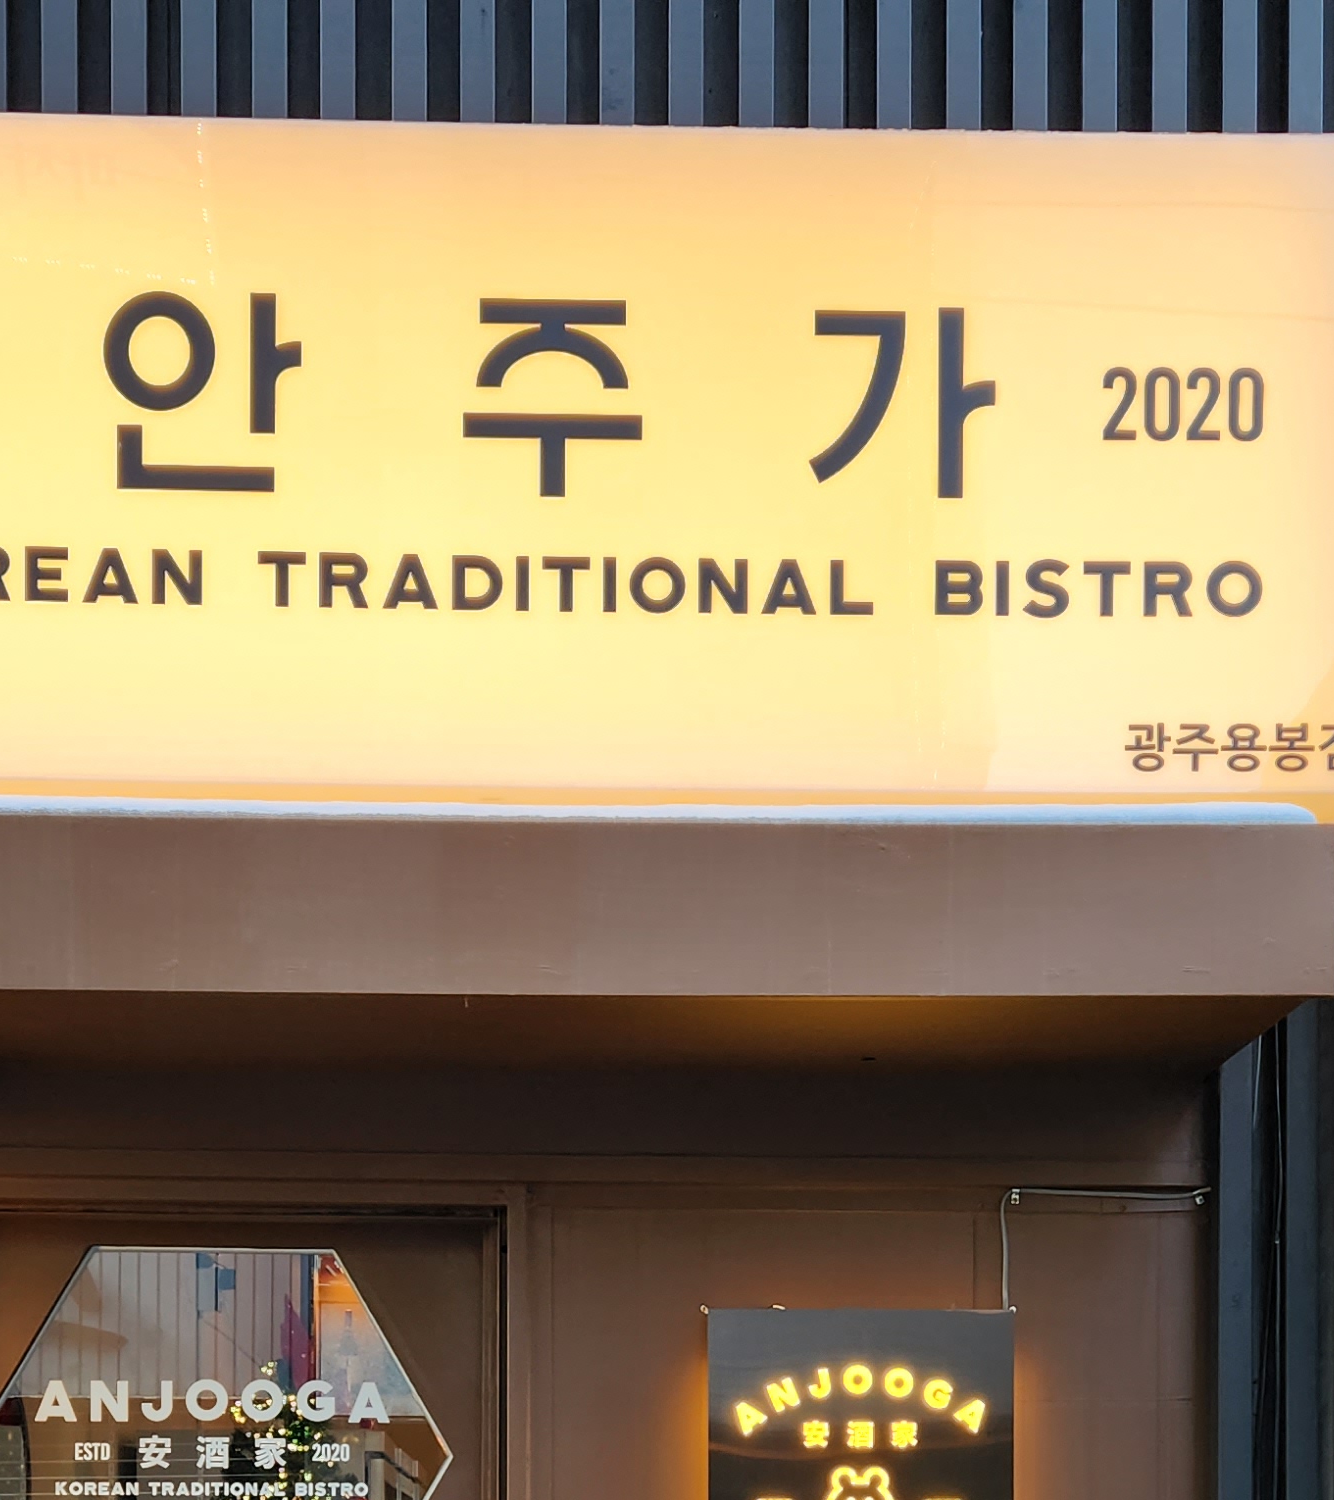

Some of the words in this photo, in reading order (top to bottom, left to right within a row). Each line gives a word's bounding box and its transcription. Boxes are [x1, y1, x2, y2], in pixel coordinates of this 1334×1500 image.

[1102, 367, 1266, 443] 2020
[257, 550, 875, 615] TRADITIONAL
[933, 558, 1264, 618] BISTRO
[34, 1379, 390, 1424] ANJOOGA
[734, 1364, 986, 1436] ANJOOGA
[74, 1442, 111, 1461] ESTD
[311, 1443, 351, 1463] 2020
[54, 1481, 140, 1496] KOREAN
[148, 1482, 286, 1497] TRADITIONAL
[294, 1482, 369, 1497] BISTRO
